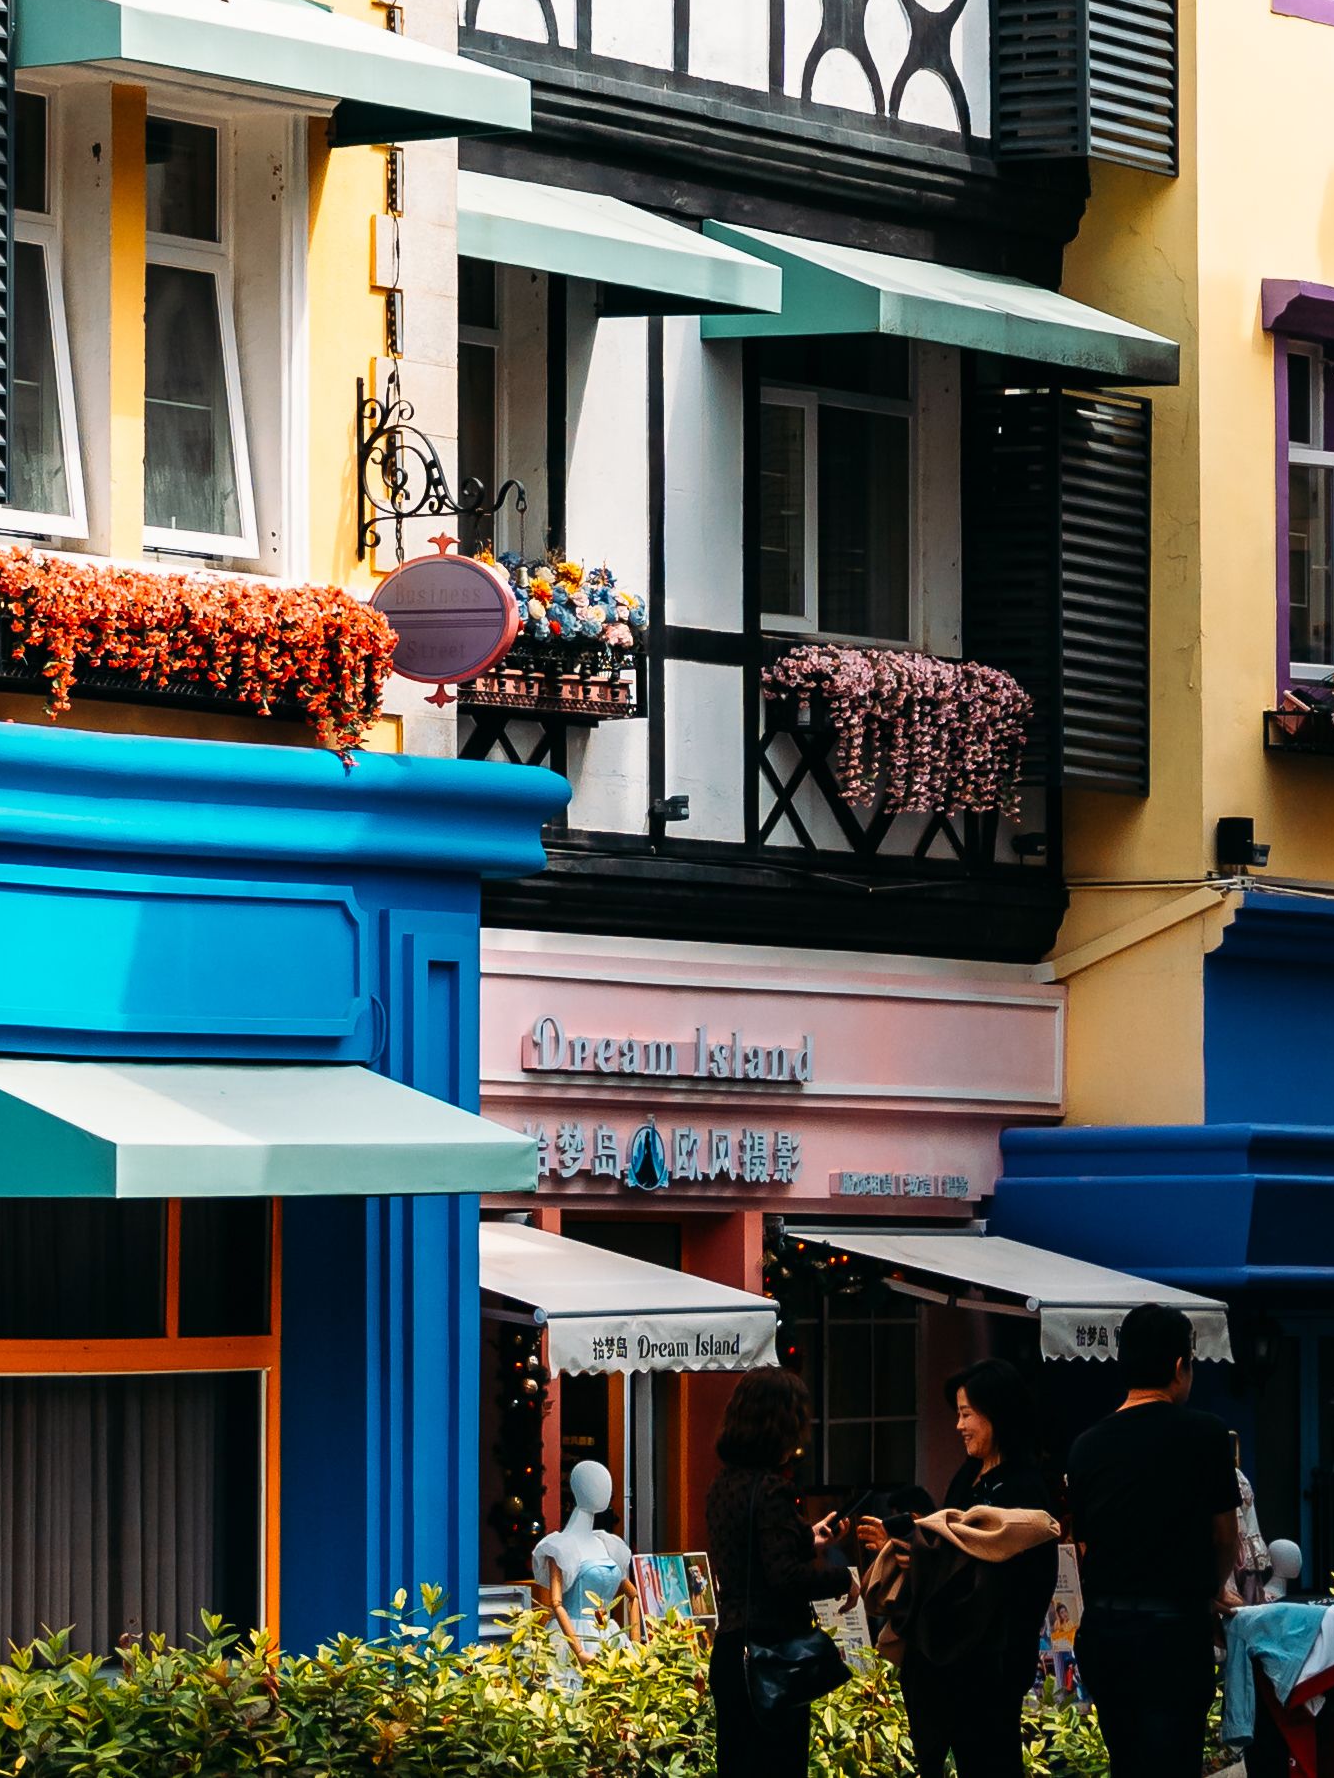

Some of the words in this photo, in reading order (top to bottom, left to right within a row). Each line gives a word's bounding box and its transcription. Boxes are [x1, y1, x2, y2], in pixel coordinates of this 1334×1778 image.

[395, 583, 482, 606] Business
[532, 1014, 678, 1076] Dream
[695, 1023, 815, 1082] Island
[672, 1126, 803, 1183] 欧风摄影
[593, 1336, 627, 1360] 拾梦岛
[638, 1334, 689, 1359] Dream
[695, 1332, 740, 1357] Island
